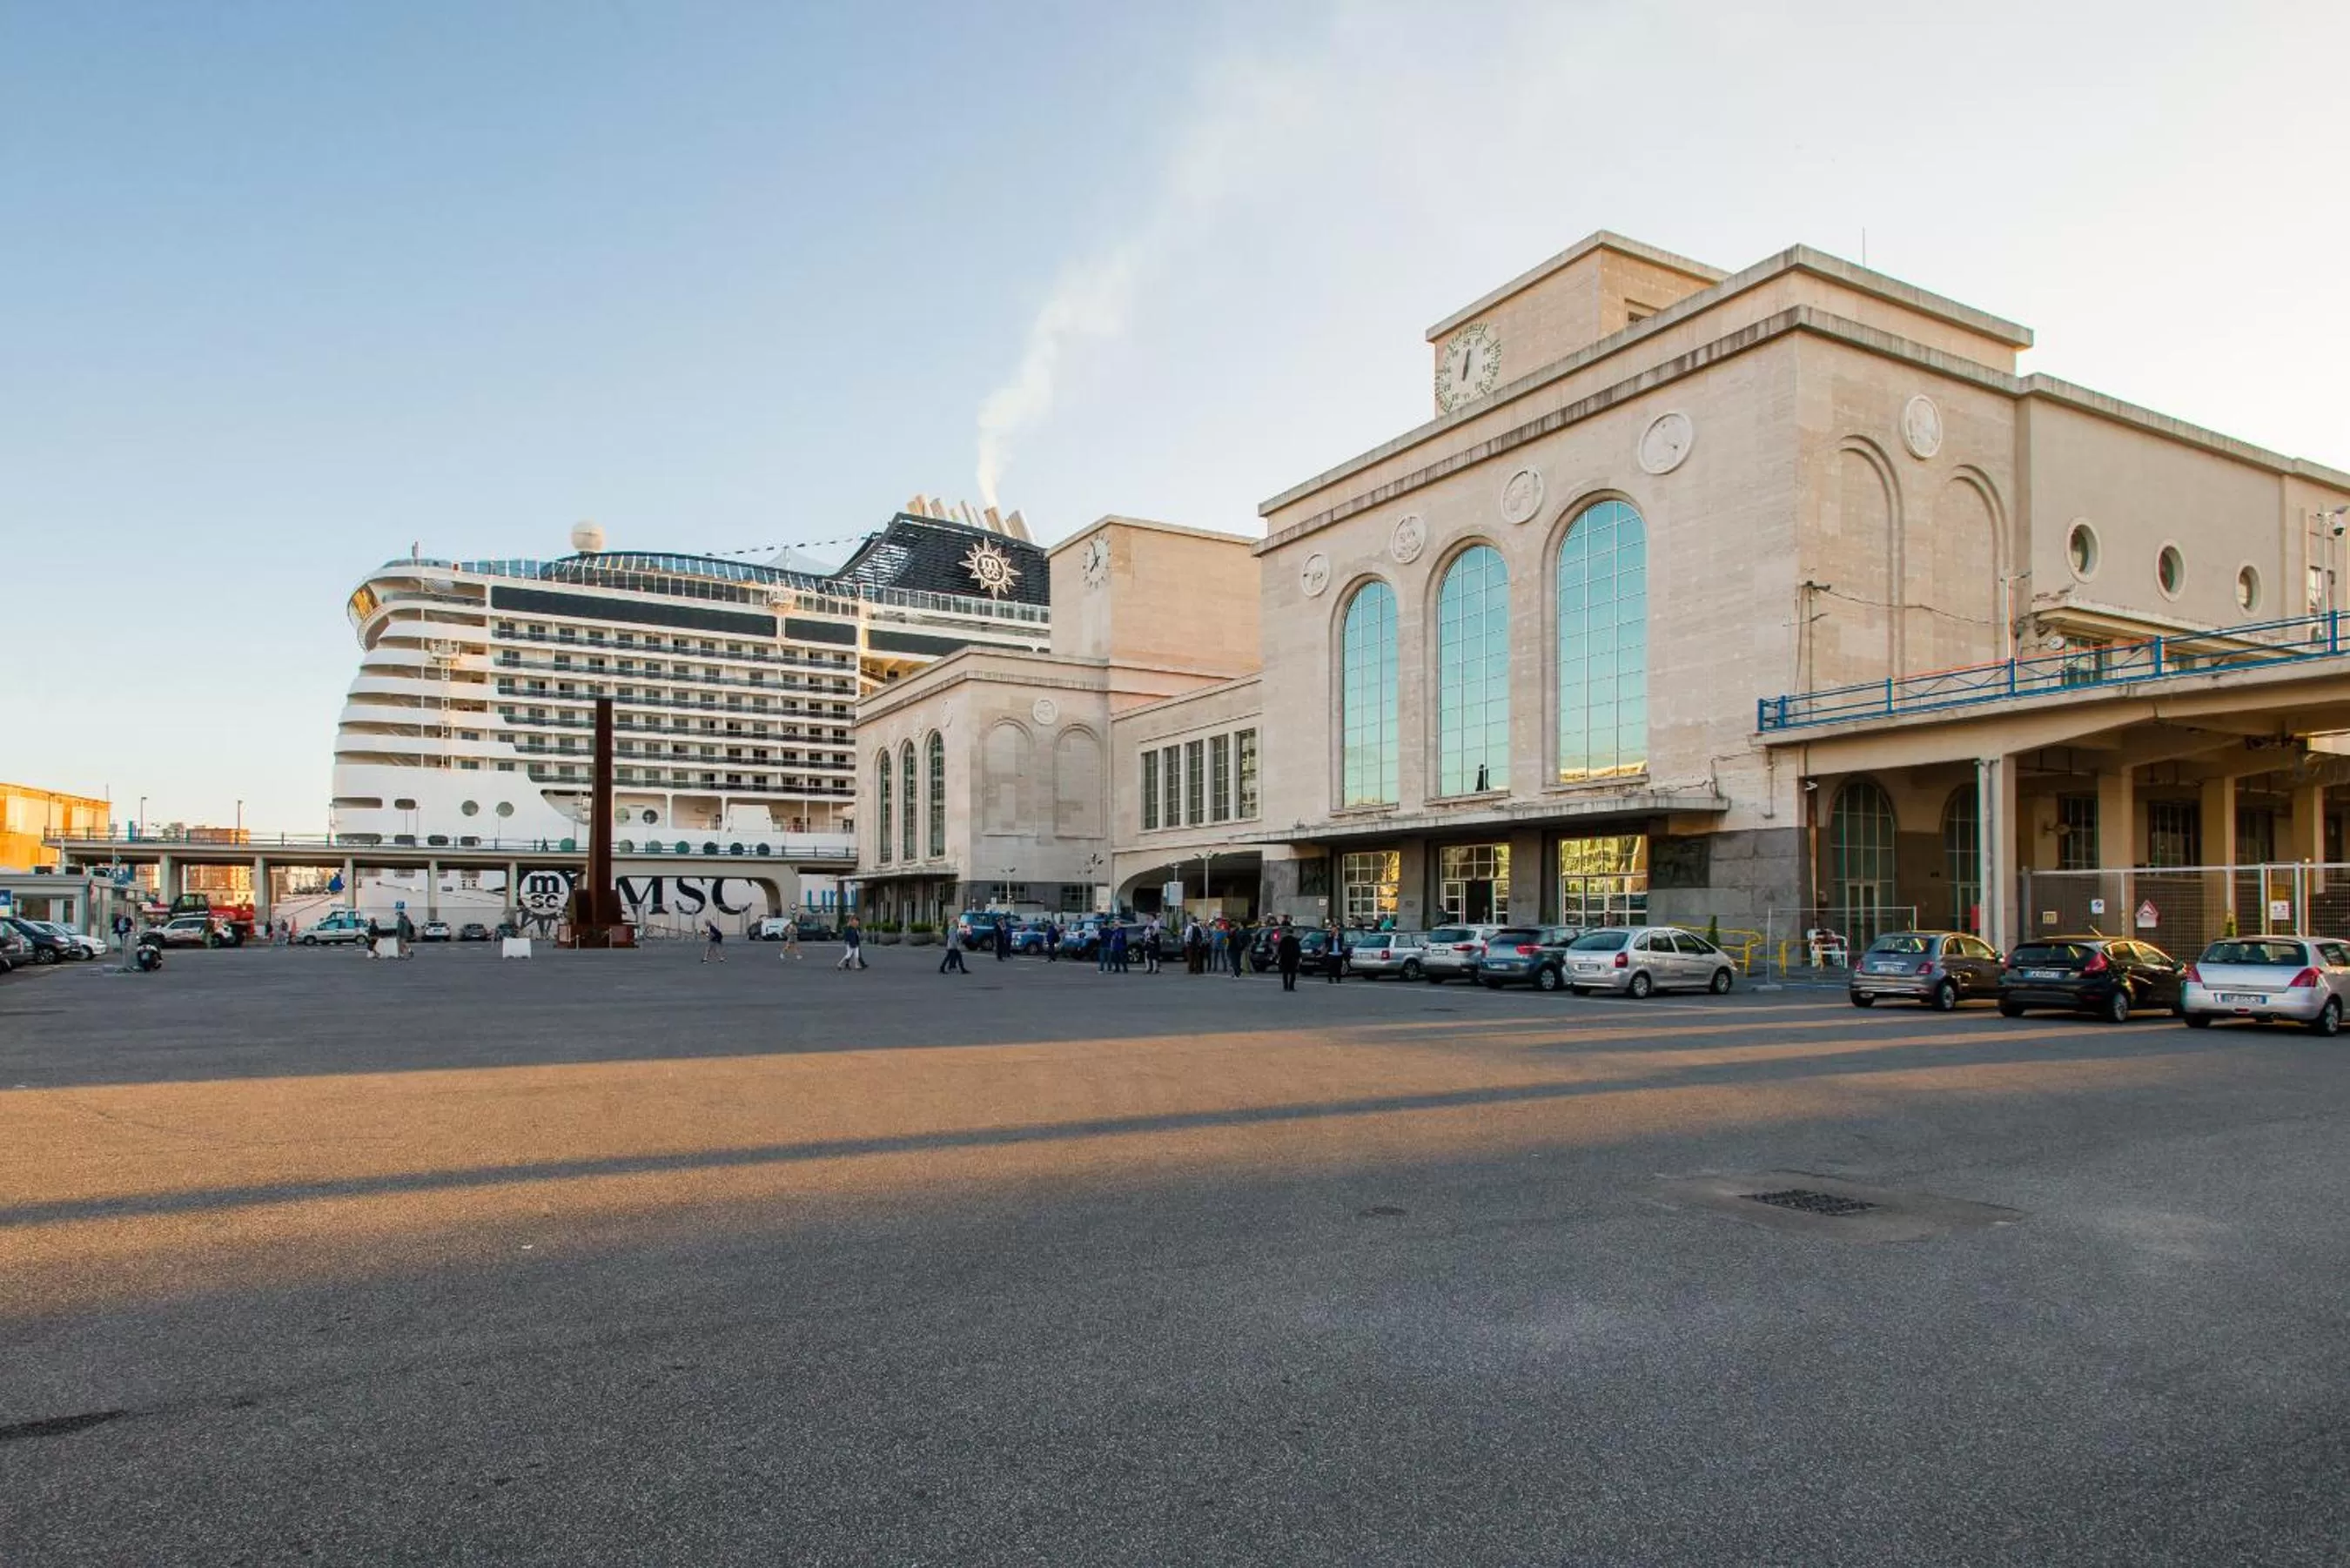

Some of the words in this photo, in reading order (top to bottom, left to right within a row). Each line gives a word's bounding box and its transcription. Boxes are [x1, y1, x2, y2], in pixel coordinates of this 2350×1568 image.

[526, 875, 564, 894] m
[531, 895, 558, 908] sc
[615, 876, 753, 915] MSC
